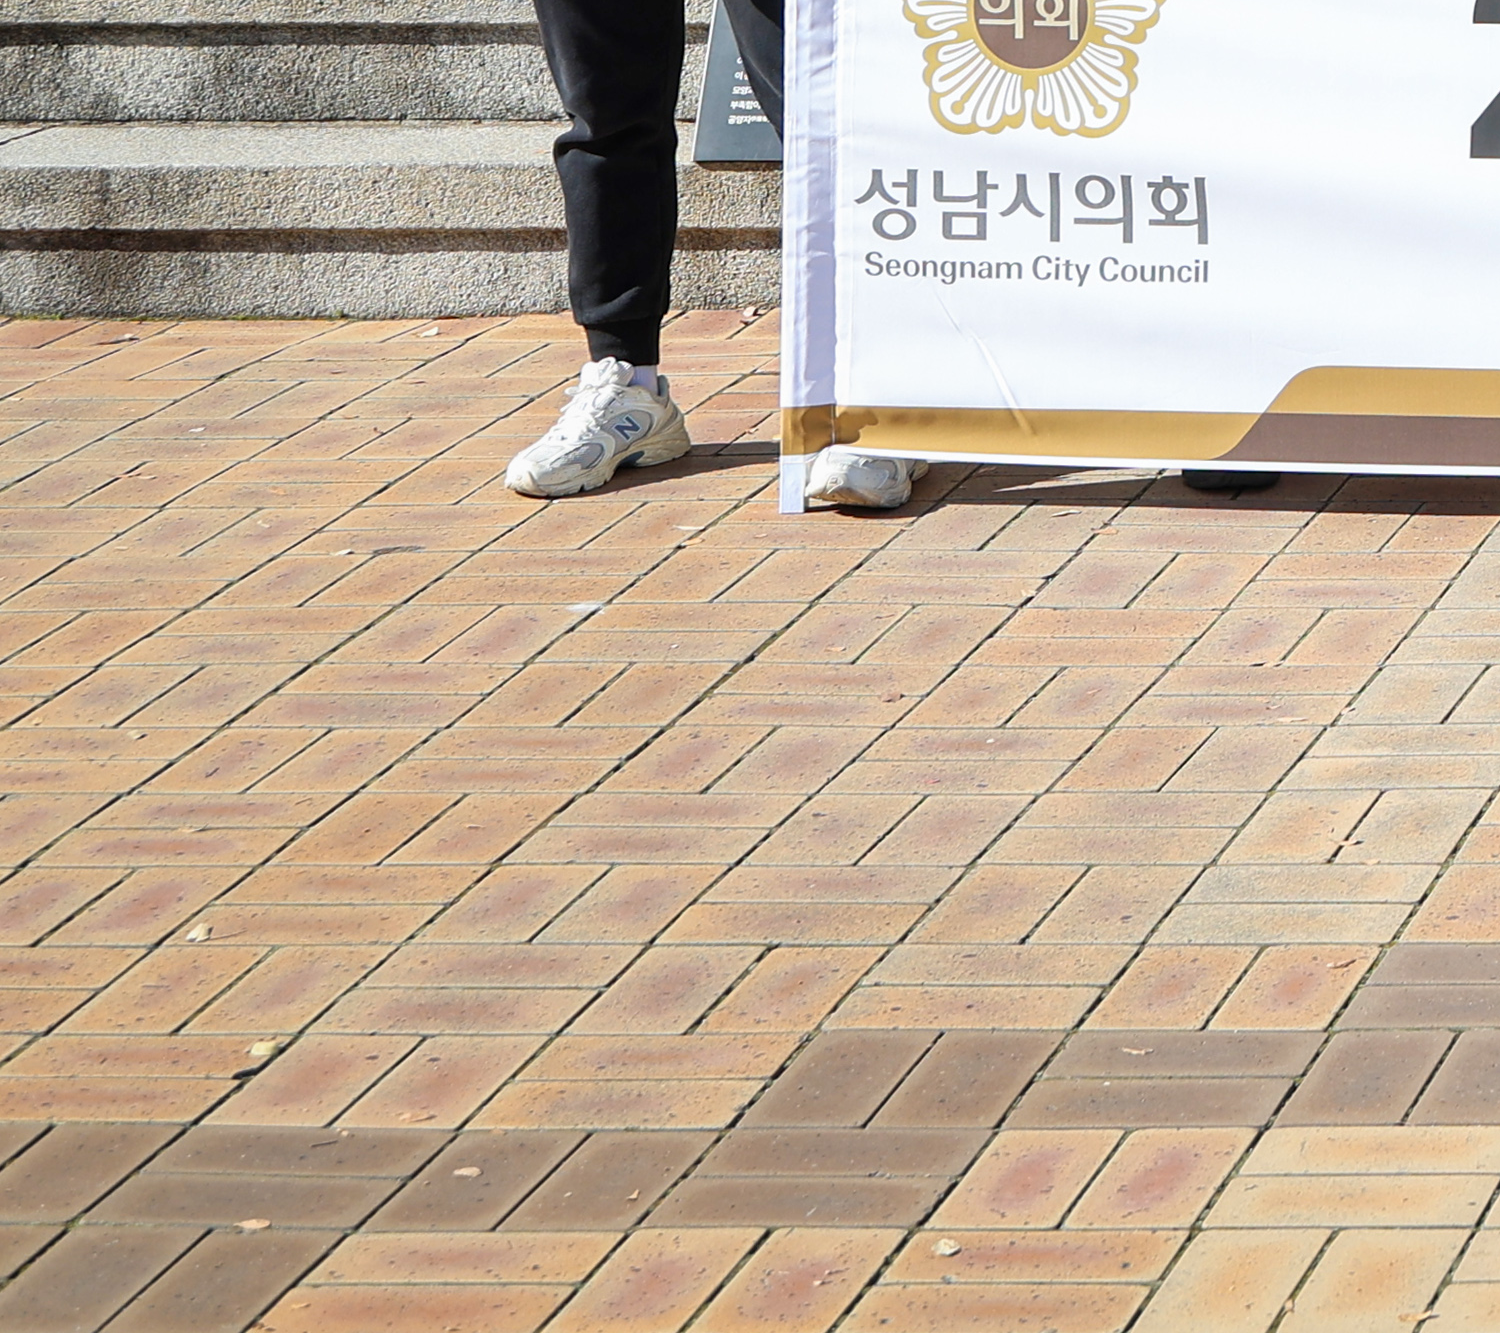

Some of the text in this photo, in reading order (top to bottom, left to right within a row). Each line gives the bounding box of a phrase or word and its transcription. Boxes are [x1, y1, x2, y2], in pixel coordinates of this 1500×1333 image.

[855, 169, 1207, 244] 성남시의회
[866, 252, 1208, 286] Seongnam City Council
